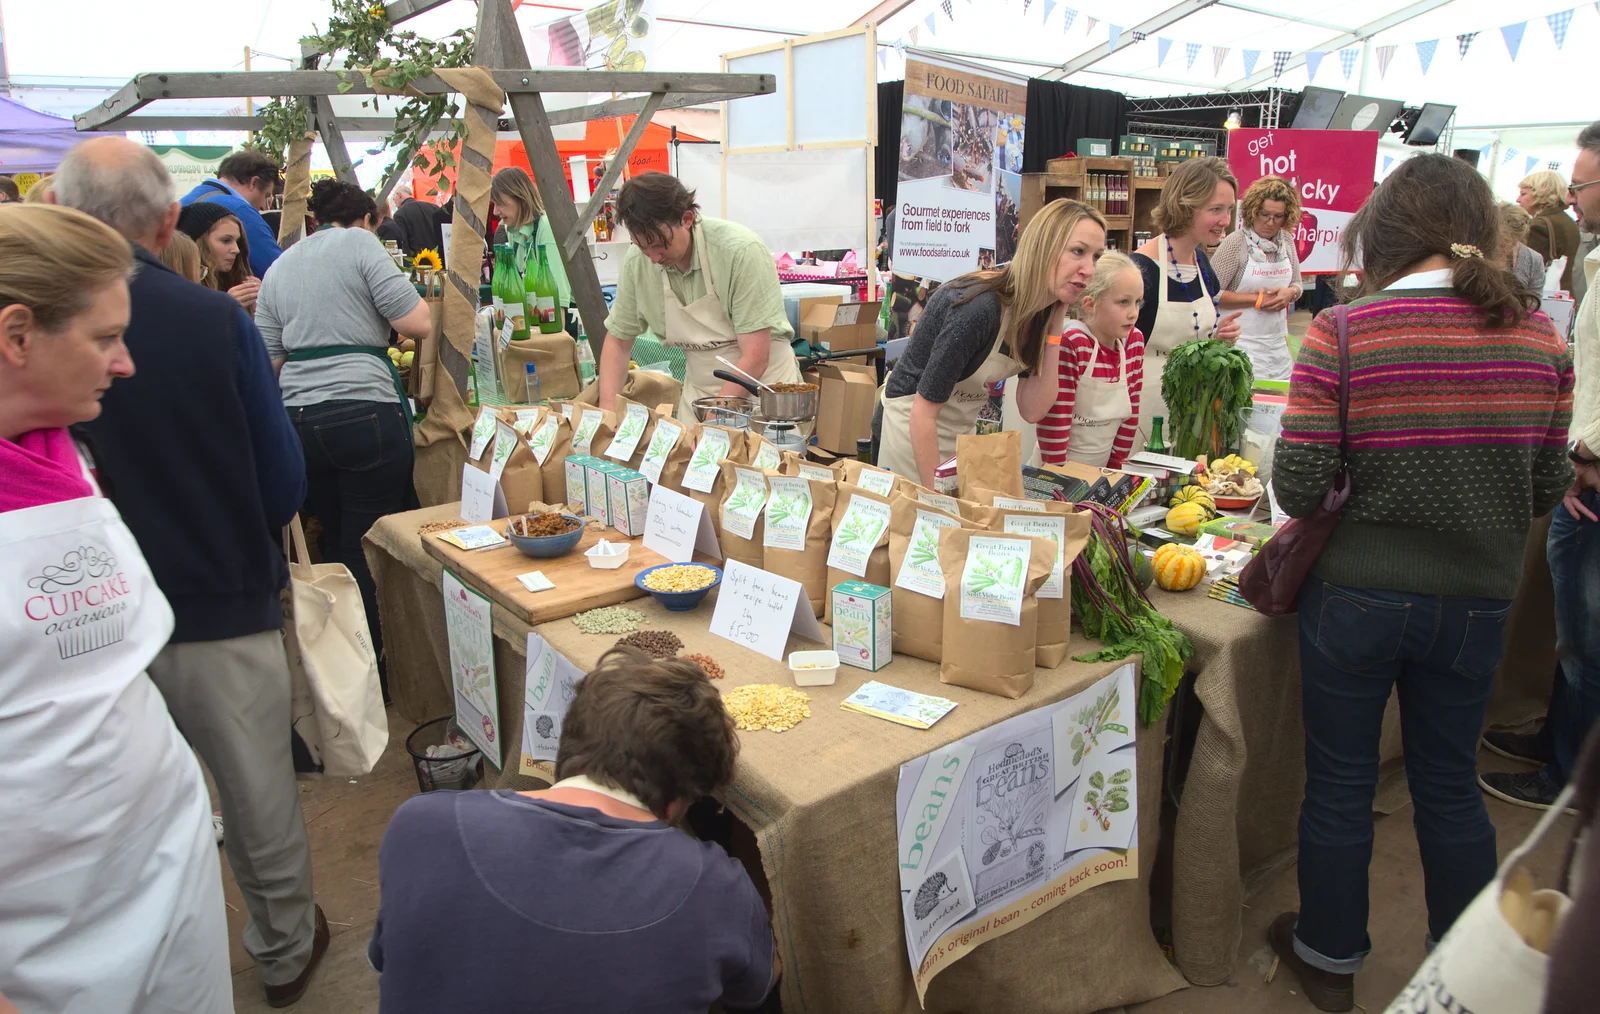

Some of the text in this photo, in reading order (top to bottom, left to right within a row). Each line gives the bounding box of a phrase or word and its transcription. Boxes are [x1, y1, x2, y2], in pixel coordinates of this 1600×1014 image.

[926, 72, 1008, 104] FOOD SAFARI
[1248, 131, 1274, 156] get
[1260, 150, 1296, 176] hot
[902, 202, 990, 222] Gourmet experiences
[902, 218, 970, 233] from field to fork
[900, 246, 970, 258] www.foodsafari.co.uk
[854, 501, 888, 516] Great British
[862, 508, 878, 517] Beans
[922, 515, 939, 524] Great
[998, 544, 1024, 552] British
[25, 572, 130, 621] CUPCAKE
[730, 568, 746, 586] Split
[772, 584, 789, 600] beans
[743, 593, 762, 606] recipe
[834, 602, 870, 622] beans
[45, 601, 128, 636] occasions
[982, 752, 1049, 784] GREAT BRITISH
[988, 746, 1042, 775] Hodmedod's
[976, 758, 1050, 808] beans
[900, 753, 960, 871] beans
[1026, 866, 1044, 880] Beans
[947, 920, 990, 951] original
[993, 908, 1020, 929] bean
[1030, 882, 1068, 910] coming
[1068, 868, 1091, 889] back
[1094, 855, 1129, 875] soon!
